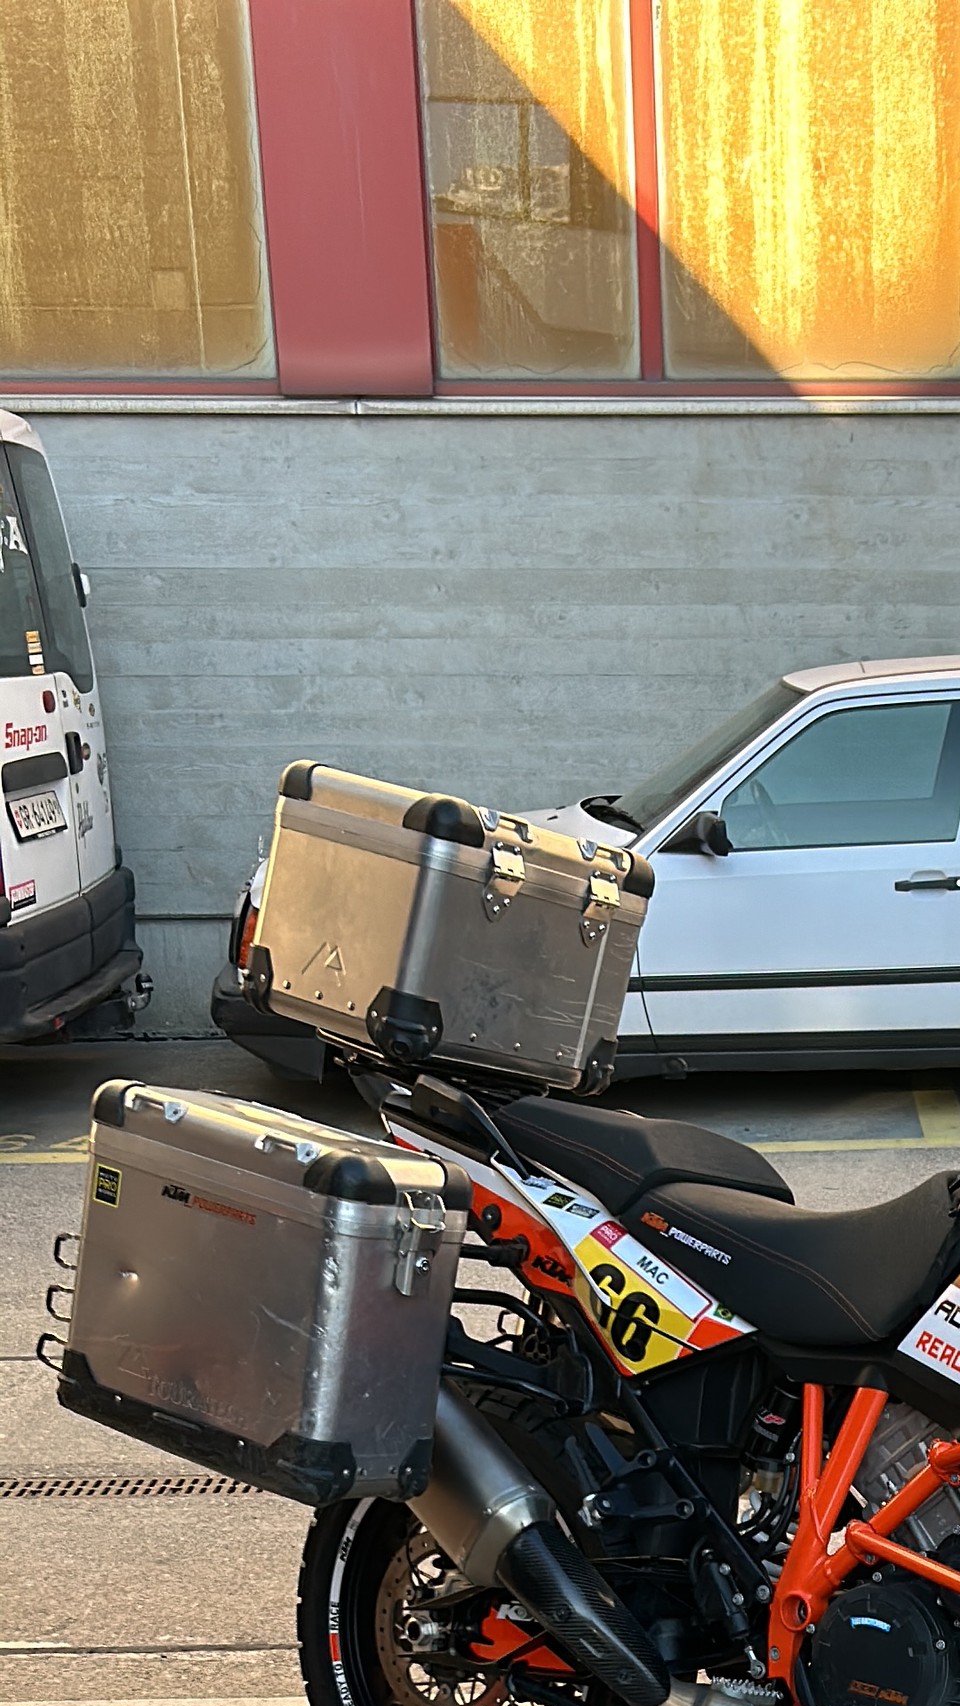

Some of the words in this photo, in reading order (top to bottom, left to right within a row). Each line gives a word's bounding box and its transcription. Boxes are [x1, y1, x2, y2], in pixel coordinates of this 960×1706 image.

[5, 722, 48, 751] Snap-on
[99, 1178, 118, 1192] PRO
[600, 1224, 619, 1242] PRO
[531, 1255, 574, 1288] KTM
[636, 1254, 670, 1285] MAC
[329, 1600, 340, 1632] RACE
[333, 1663, 345, 1678] TO
